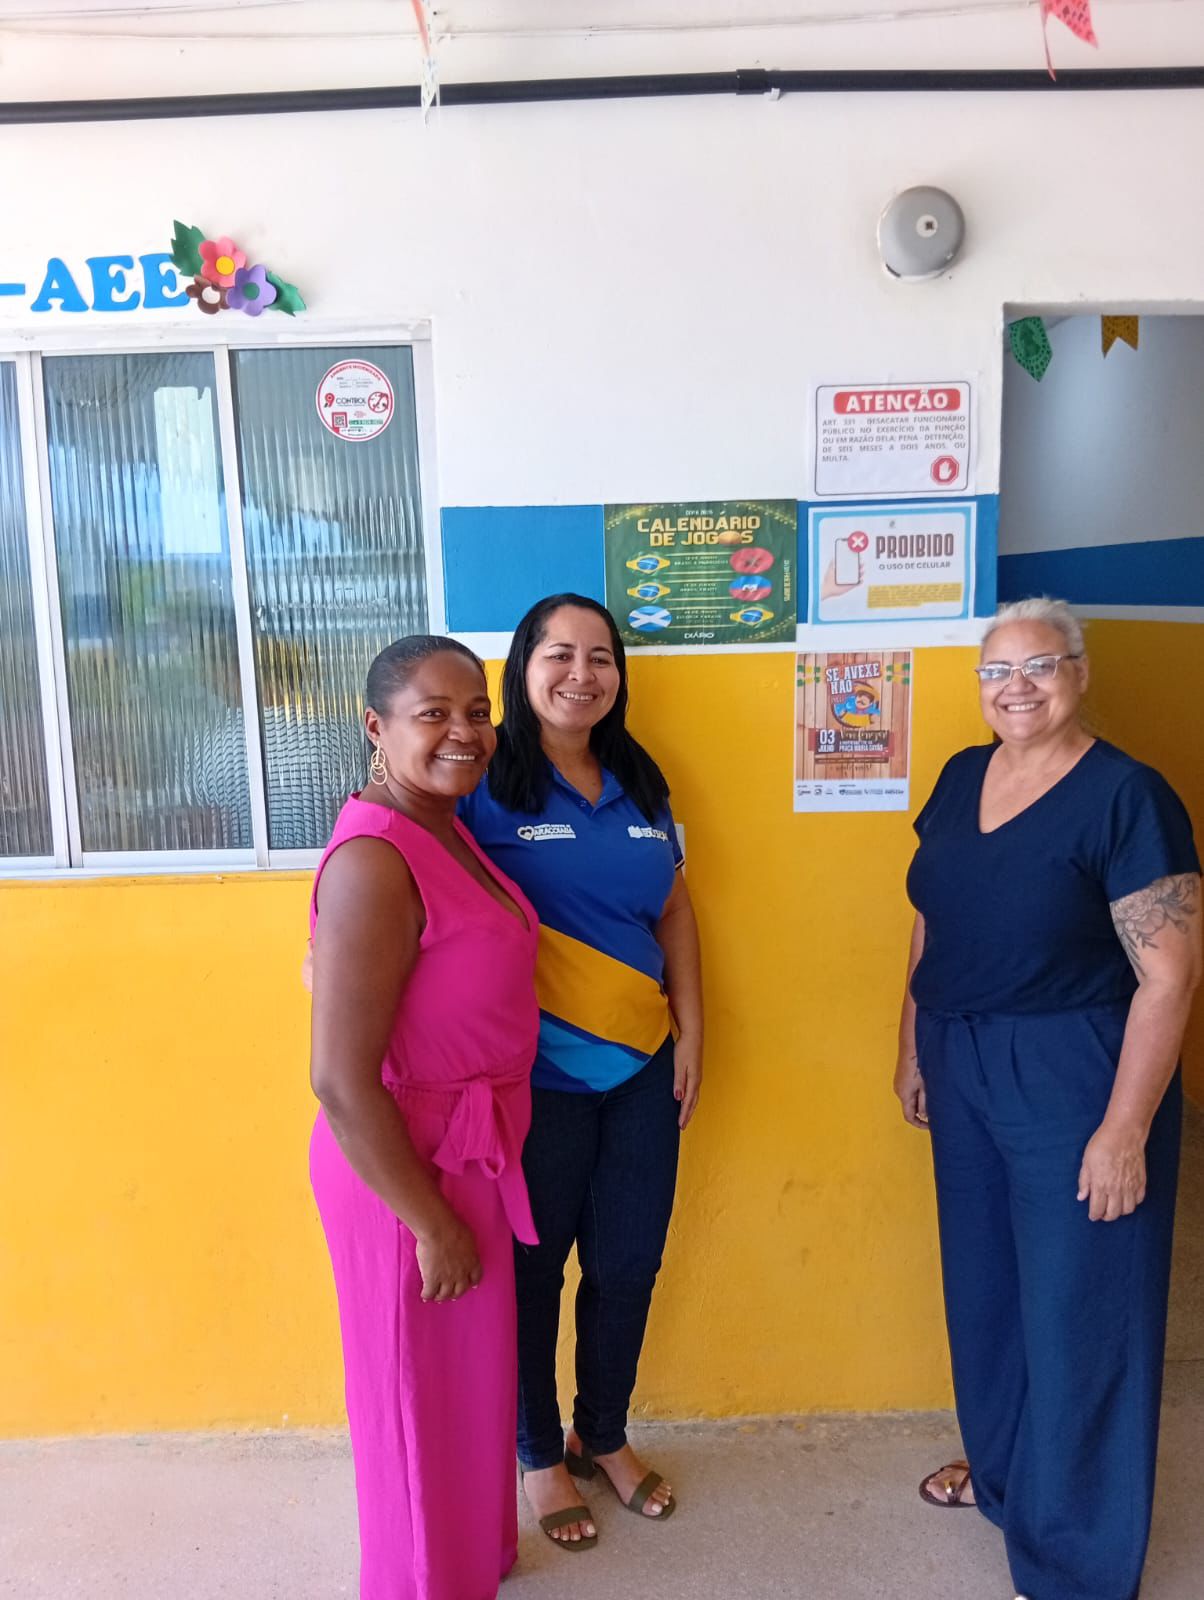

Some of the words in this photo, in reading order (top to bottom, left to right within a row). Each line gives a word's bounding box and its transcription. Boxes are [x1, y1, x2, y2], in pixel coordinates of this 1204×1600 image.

[846, 389, 949, 412] ATENÇÃO
[867, 417, 910, 425] DESACATAR
[914, 415, 966, 423] FUNCIONÁRIO
[822, 426, 855, 435] PÚBLICO
[876, 425, 914, 433] EXERCÍCIO
[934, 424, 966, 432] FUNÇÃO
[849, 435, 874, 443] RAZÃO
[859, 444, 883, 452] MESES
[900, 443, 919, 451] DOIS
[637, 511, 761, 532] CALENDÁRIO
[650, 532, 675, 547] DE
[875, 533, 954, 559] PROIBIDO
[916, 561, 951, 569] CELULAR
[826, 667, 840, 682] SE
[844, 662, 880, 680] AVEXE
[820, 729, 835, 745] 03
